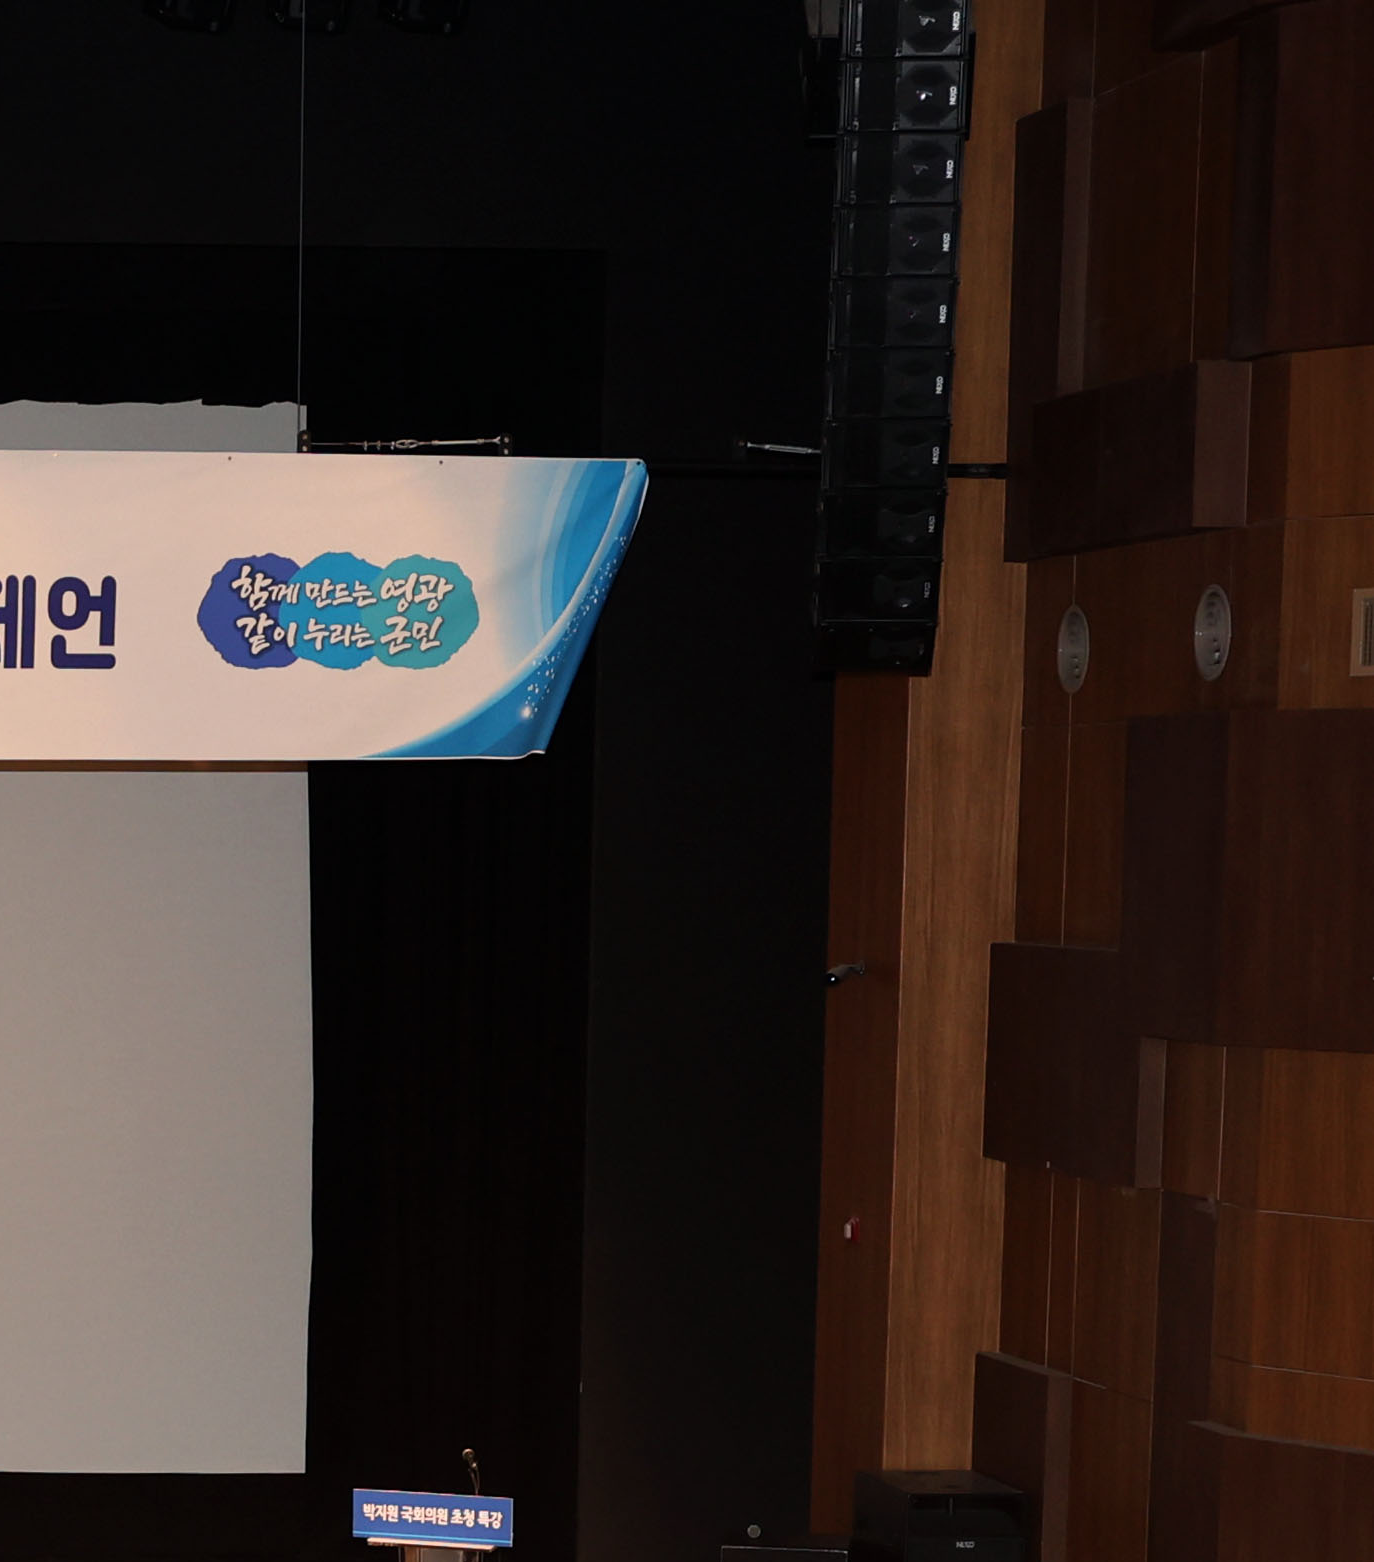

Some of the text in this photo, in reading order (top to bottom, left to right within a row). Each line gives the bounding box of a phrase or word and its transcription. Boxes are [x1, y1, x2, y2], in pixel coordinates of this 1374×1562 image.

[231, 565, 454, 613] 함께 만드는 영광
[235, 613, 444, 655] 같이 누리는 군민
[362, 1503, 503, 1529] 박지원 국회의원 초청 특강
